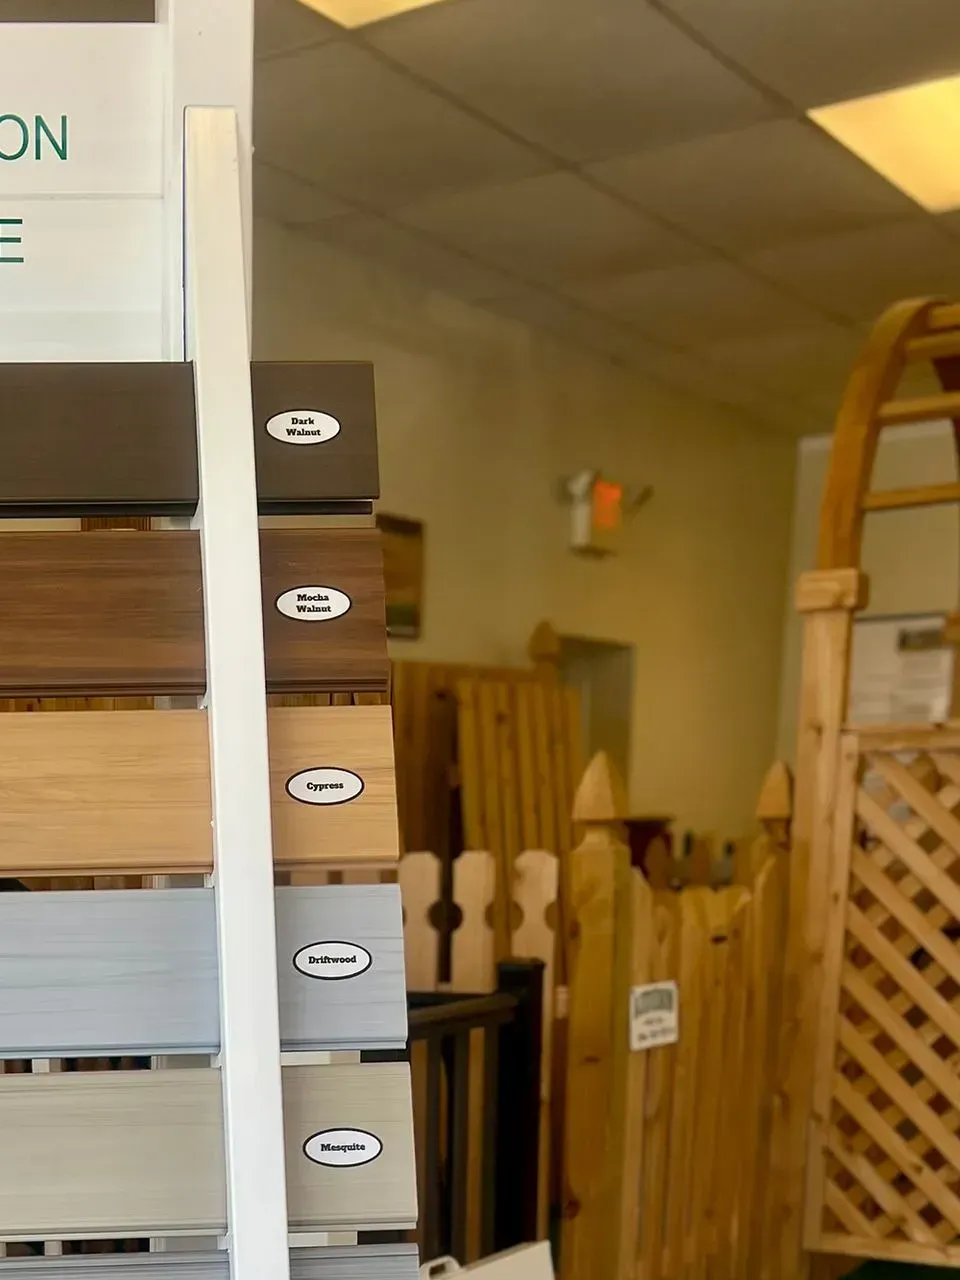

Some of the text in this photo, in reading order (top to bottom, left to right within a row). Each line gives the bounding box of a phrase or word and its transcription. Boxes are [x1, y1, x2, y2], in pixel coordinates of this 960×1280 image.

[291, 416, 315, 425] Dark
[285, 428, 322, 437] Walnut
[296, 593, 330, 602] Mocha
[295, 604, 332, 613] Walnut
[306, 781, 344, 792] Cypress
[308, 955, 358, 965] Driftwood
[320, 1142, 366, 1154] Mesquite
